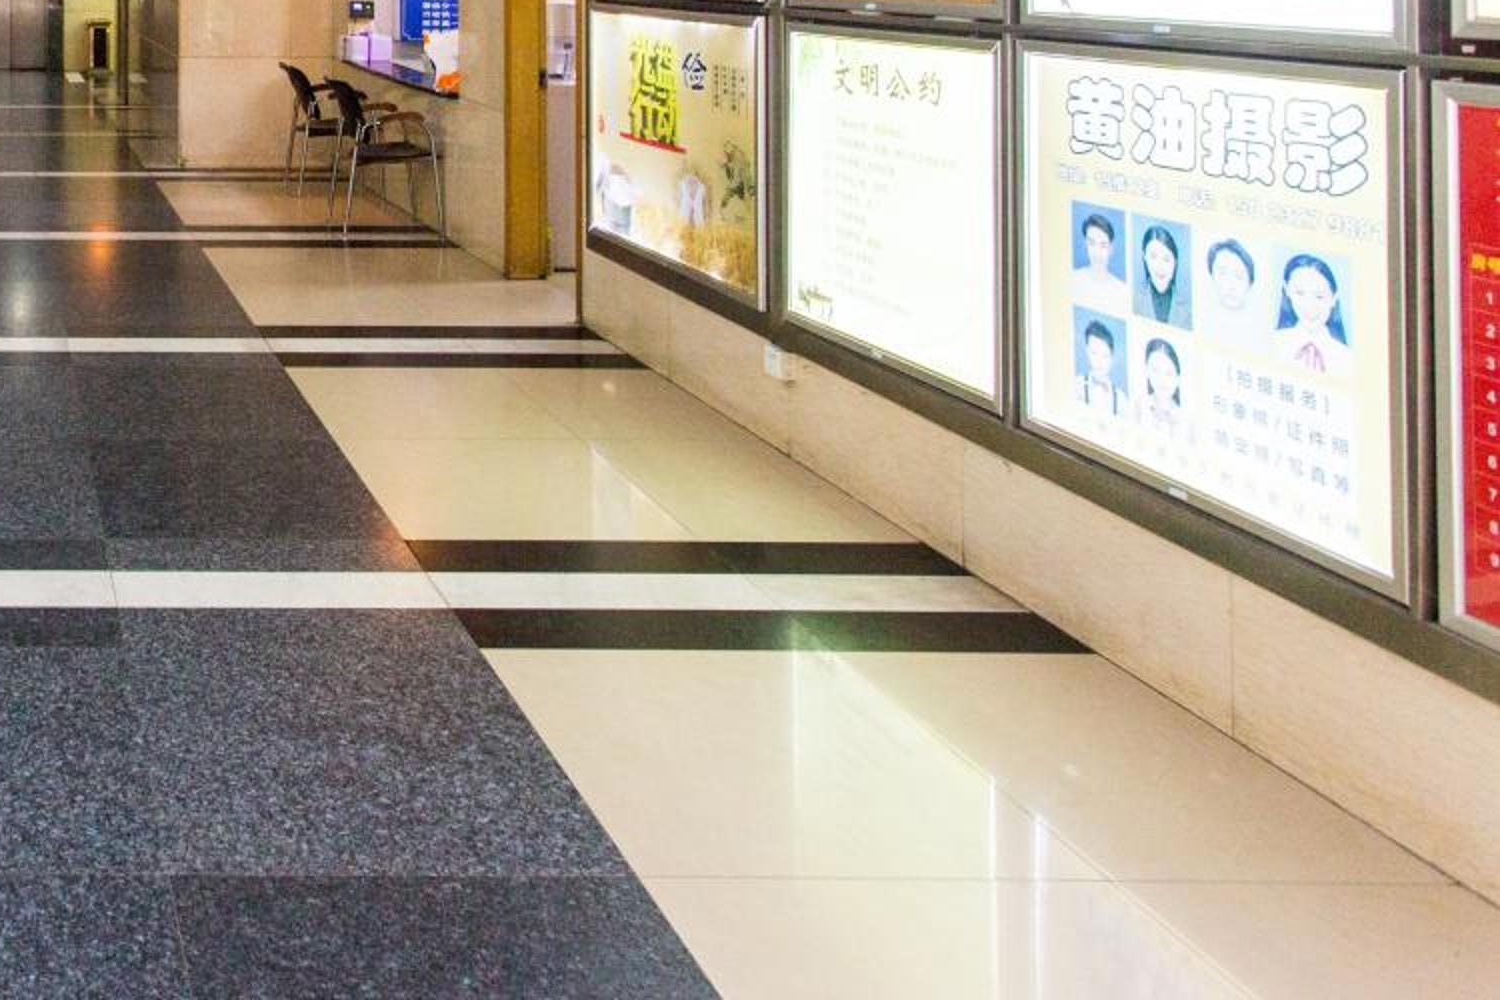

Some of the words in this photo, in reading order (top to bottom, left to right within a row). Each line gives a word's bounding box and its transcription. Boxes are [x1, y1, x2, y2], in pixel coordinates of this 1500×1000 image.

[834, 59, 943, 107] 文明公约
[1066, 76, 1369, 196] 黄油摄影
[1488, 487, 1498, 502] 7
